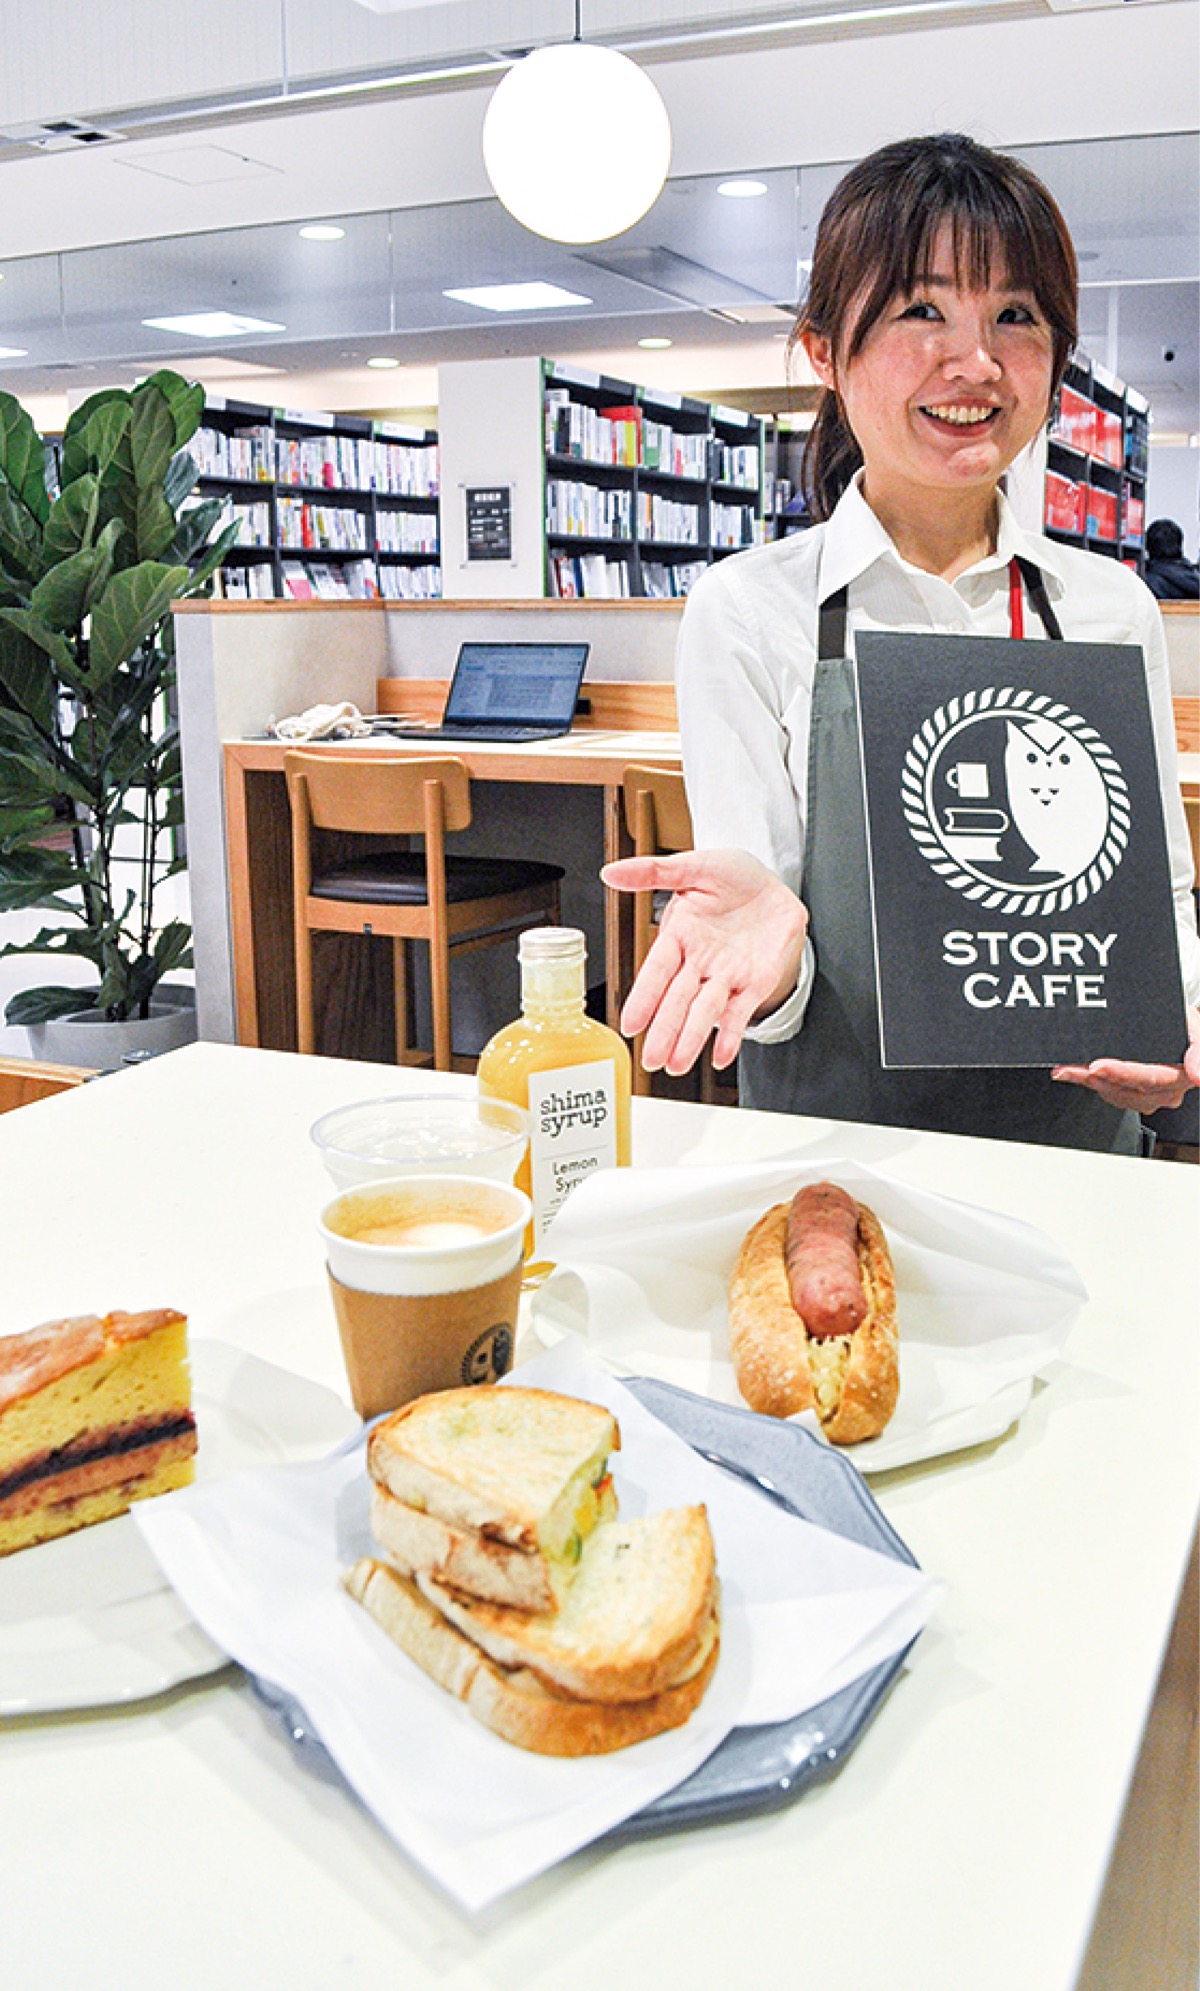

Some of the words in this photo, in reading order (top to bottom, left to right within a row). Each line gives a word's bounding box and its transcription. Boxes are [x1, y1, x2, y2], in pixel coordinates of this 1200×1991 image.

[942, 930, 1118, 967] STORY
[963, 972, 1108, 1009] CAFE
[540, 1088, 607, 1115] shima
[540, 1106, 608, 1137] syrup
[553, 1157, 598, 1176] Lemon
[556, 1177, 587, 1194] Syr
